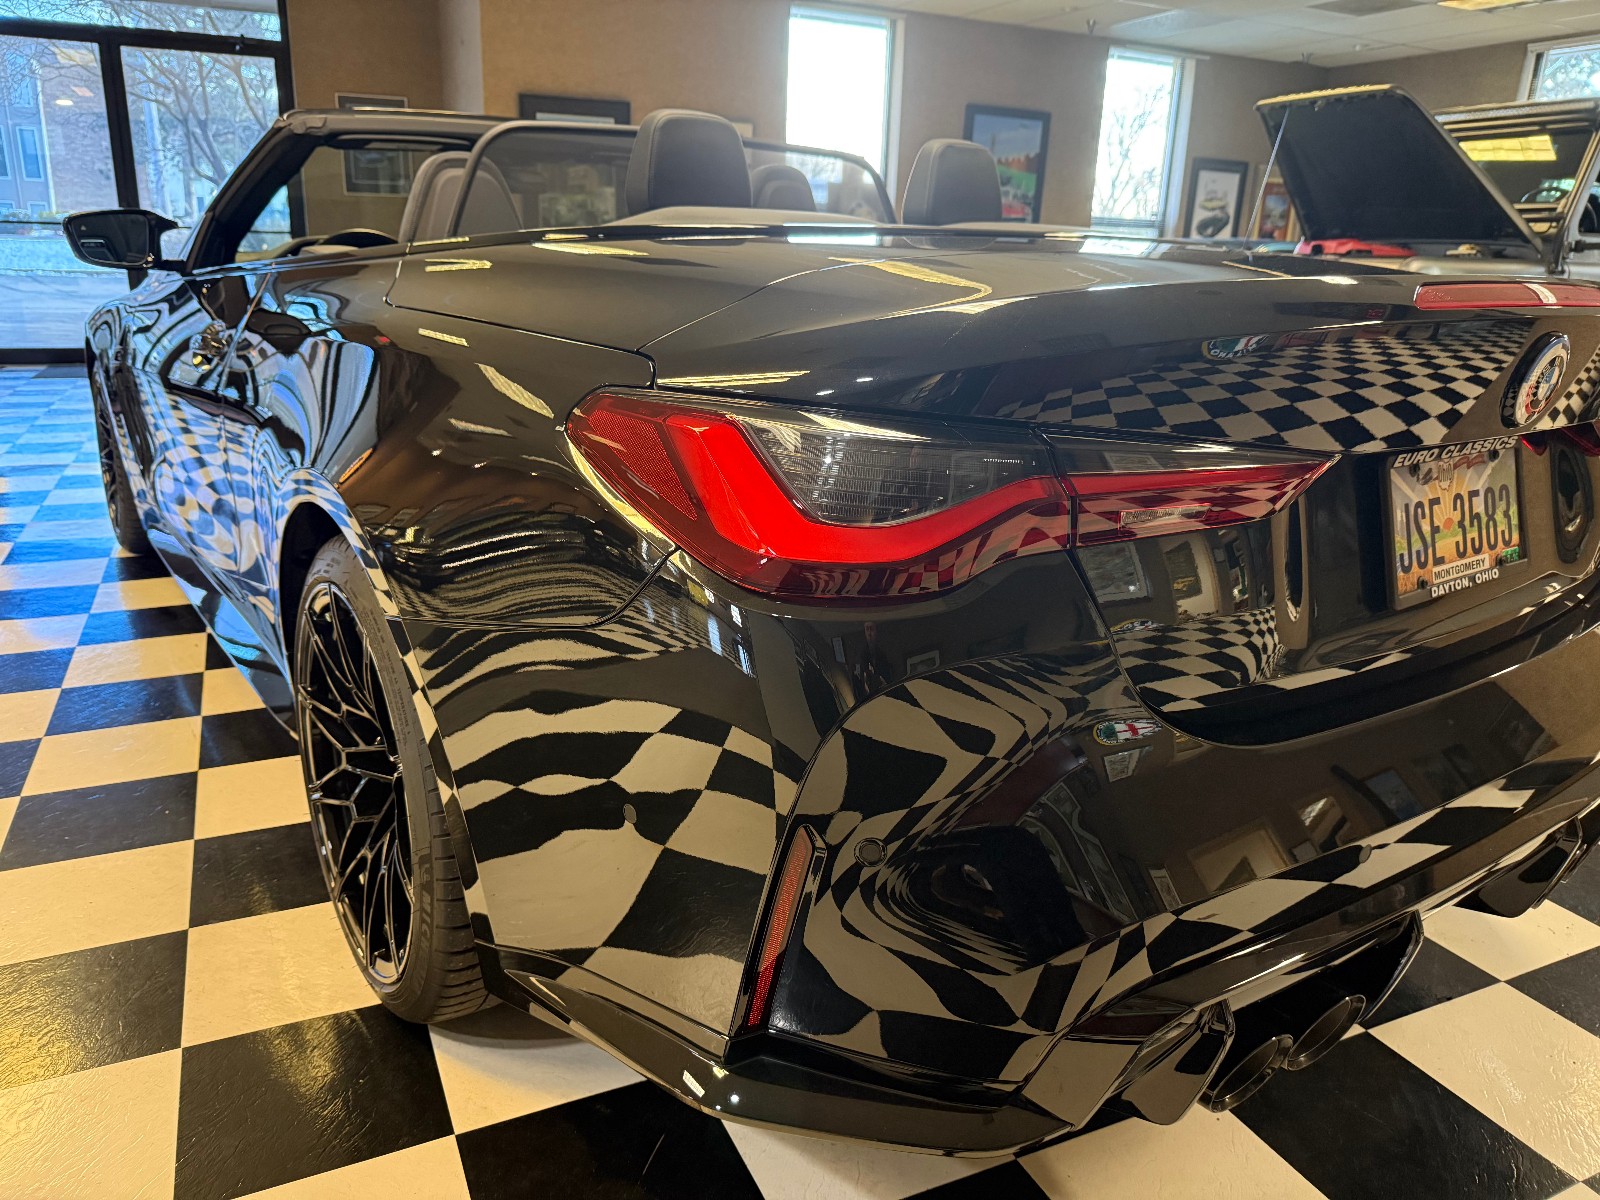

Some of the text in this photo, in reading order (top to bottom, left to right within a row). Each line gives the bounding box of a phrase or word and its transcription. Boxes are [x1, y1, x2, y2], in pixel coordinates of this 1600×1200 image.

[1394, 436, 1518, 467] EURO CLASSICS
[1399, 484, 1512, 574] JSE 3583
[1431, 568, 1499, 598] DAYTON, OHIO
[1433, 557, 1486, 581] MONTGOMERY
